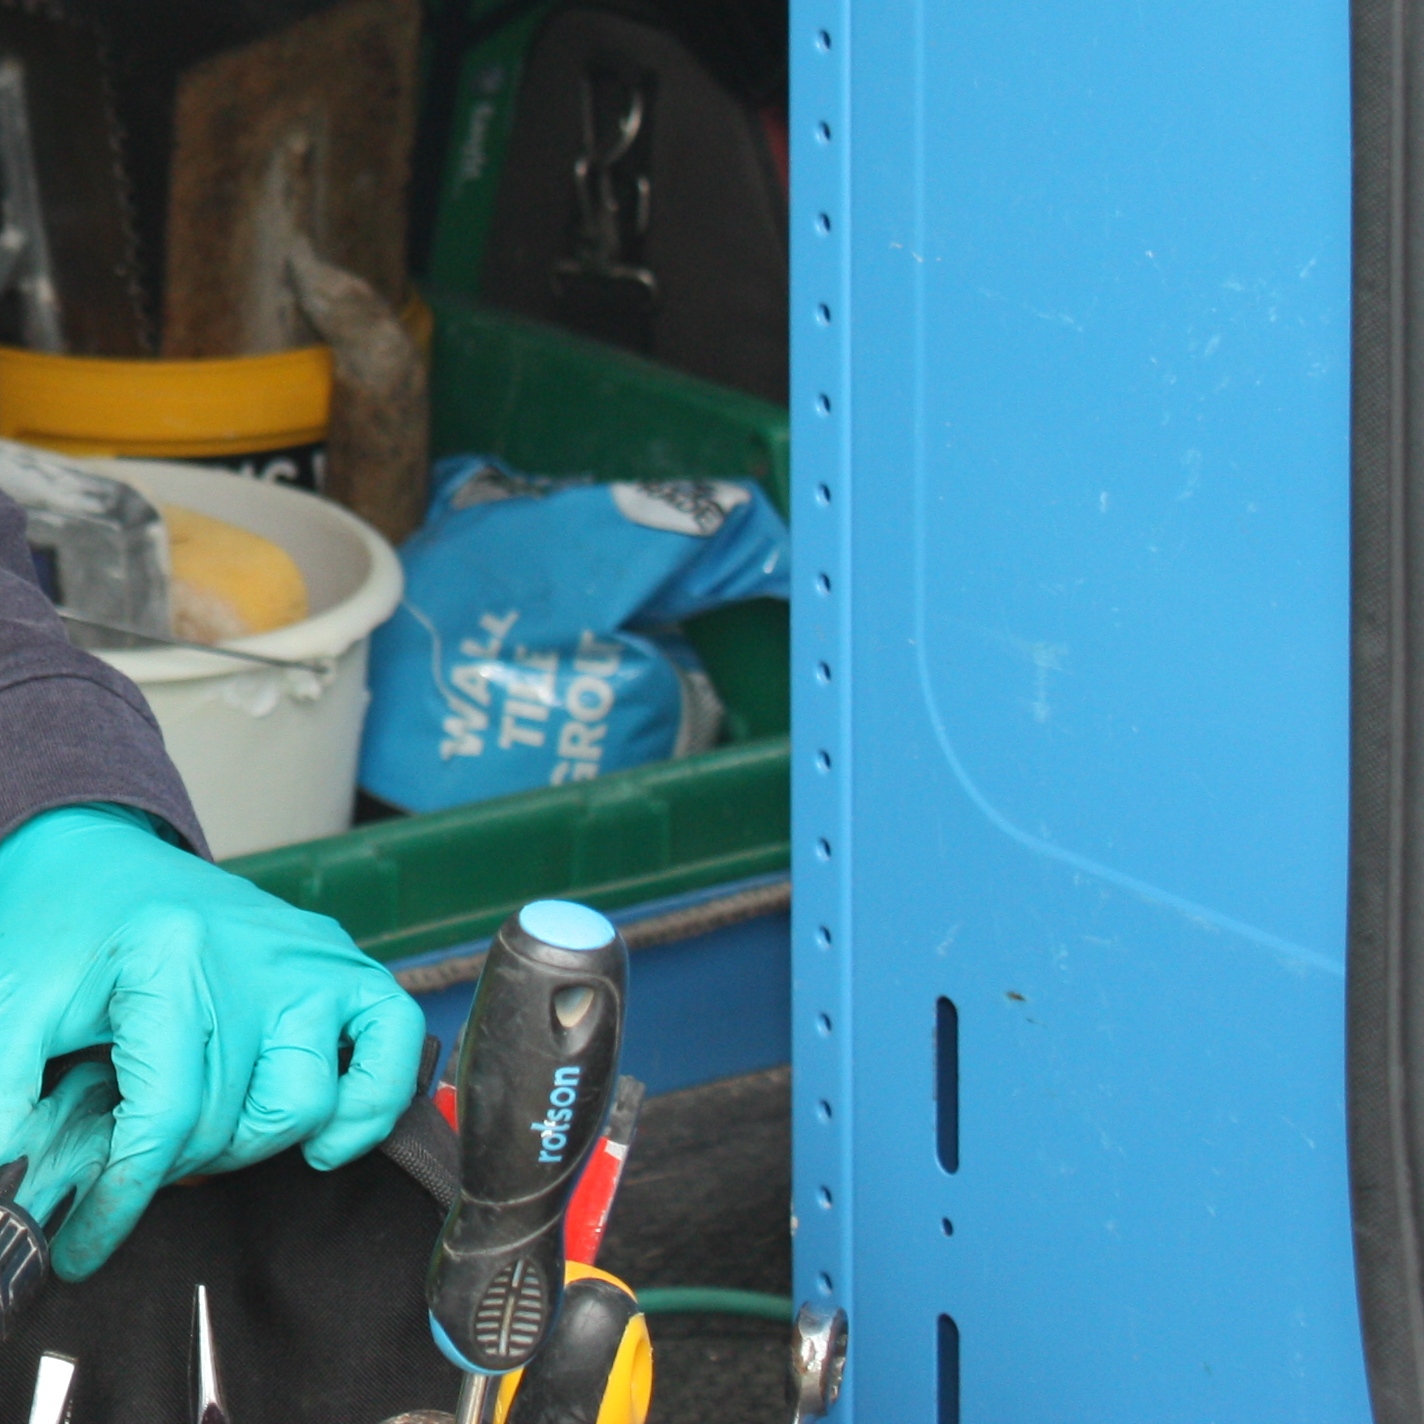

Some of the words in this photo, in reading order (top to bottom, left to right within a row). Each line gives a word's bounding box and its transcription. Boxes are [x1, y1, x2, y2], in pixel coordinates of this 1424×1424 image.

[439, 609, 520, 762] WALL
[498, 644, 559, 749] TILE
[549, 629, 625, 786] GROUT
